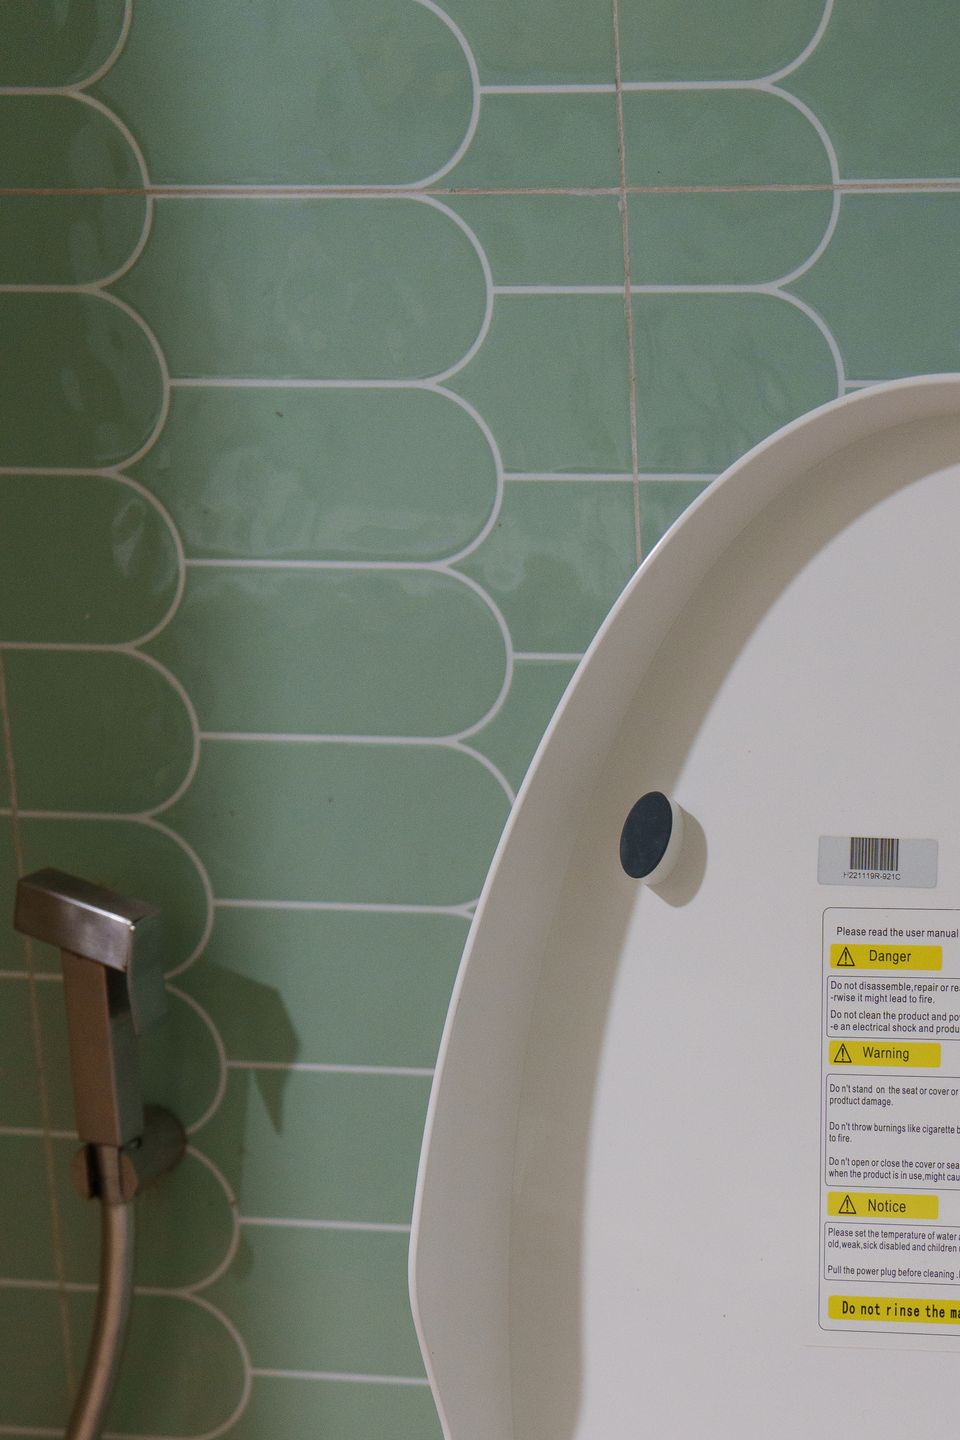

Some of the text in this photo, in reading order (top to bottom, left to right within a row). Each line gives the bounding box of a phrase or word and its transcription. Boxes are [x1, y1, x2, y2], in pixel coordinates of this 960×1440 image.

[836, 927, 867, 936] Please
[868, 927, 888, 937] read
[889, 928, 904, 937] the
[926, 928, 959, 938] manual
[869, 949, 912, 965] Danger
[830, 981, 843, 990] Do
[844, 981, 858, 991] not
[857, 993, 863, 1002] it
[864, 993, 888, 1005] might
[889, 994, 907, 1003] lead
[908, 994, 917, 1003] to
[919, 994, 935, 1004] fire.
[830, 1010, 842, 1019] Do
[843, 1010, 858, 1019] not
[858, 1010, 882, 1020] clean
[883, 1011, 897, 1020] the
[898, 1011, 930, 1022] product
[931, 1012, 947, 1021] and
[852, 1022, 891, 1032] electrical
[892, 1023, 917, 1033] shock
[918, 1024, 934, 1033] and
[862, 1046, 910, 1061] Warning
[852, 1085, 873, 1094] stand
[875, 1087, 886, 1095] on
[888, 1086, 901, 1095] the
[901, 1086, 919, 1096] seat
[919, 1088, 928, 1096] or
[928, 1088, 949, 1096] cover
[950, 1089, 959, 1097] or
[861, 1096, 894, 1108] damage.
[852, 1122, 873, 1132] throw
[873, 1123, 906, 1135] burnings
[907, 1124, 921, 1133] like
[922, 1124, 955, 1136] cigarette
[829, 1133, 853, 1143] to fire.
[851, 1159, 870, 1169] open
[880, 1158, 900, 1168] close
[901, 1159, 914, 1169] the
[915, 1161, 936, 1169] cover
[937, 1162, 946, 1170] or
[828, 1169, 848, 1178] when
[849, 1169, 862, 1179] the
[863, 1169, 891, 1181] product
[892, 1170, 899, 1180] is
[900, 1170, 907, 1180] in
[867, 1198, 907, 1213] Notice
[827, 1228, 853, 1238] Please
[854, 1229, 867, 1238] set
[868, 1229, 879, 1239] the
[880, 1230, 926, 1241] temperature
[927, 1231, 935, 1241] of
[936, 1231, 957, 1241] water
[879, 1241, 910, 1251] disabled
[912, 1242, 926, 1252] and
[927, 1243, 957, 1253] children
[827, 1265, 842, 1275] Pull
[843, 1265, 855, 1275] the
[856, 1268, 879, 1277] power
[880, 1267, 897, 1279] plug
[898, 1268, 922, 1278] before
[923, 1269, 955, 1281] cleaning
[842, 1301, 856, 1315] Do
[861, 1302, 881, 1316] not
[886, 1303, 920, 1317] rinse
[925, 1304, 945, 1318] the
